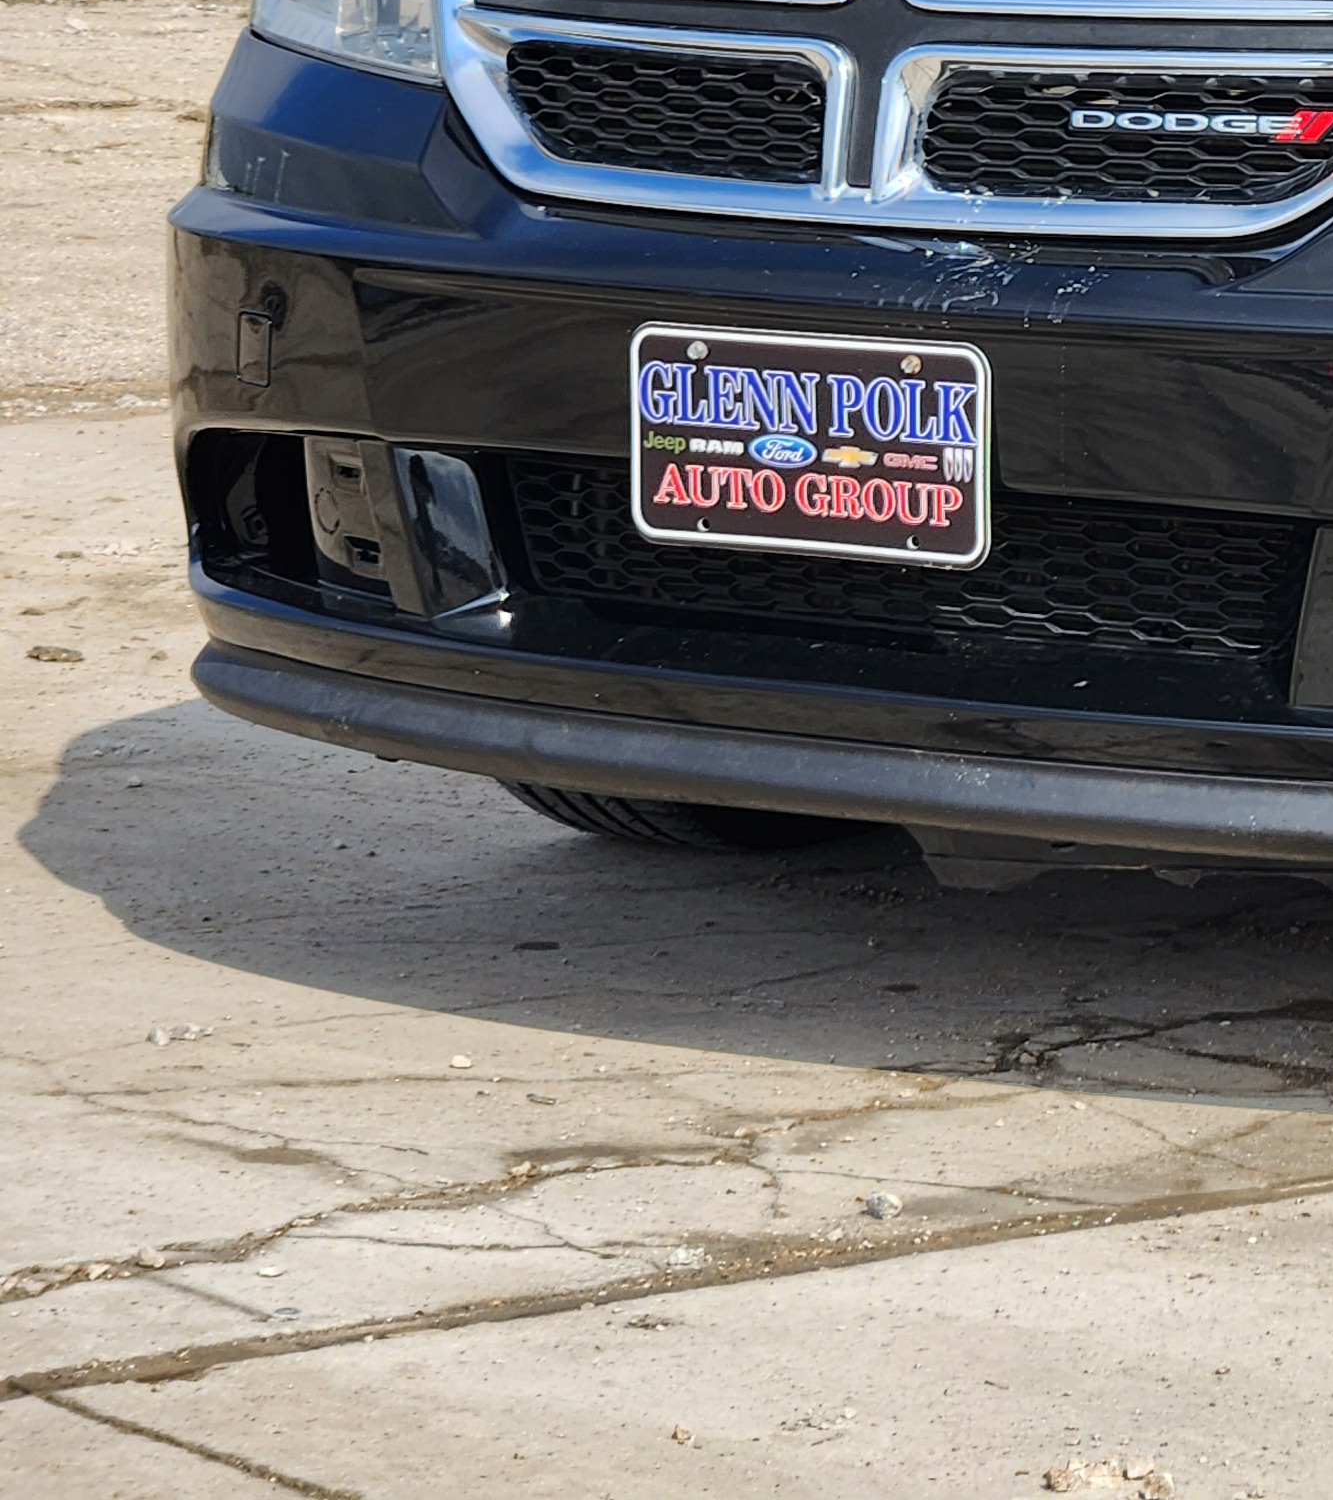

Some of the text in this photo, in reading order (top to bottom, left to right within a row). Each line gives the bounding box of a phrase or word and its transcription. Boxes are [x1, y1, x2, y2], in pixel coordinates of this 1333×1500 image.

[1070, 109, 1303, 135] DODGE
[638, 360, 978, 447] GLENN POLK
[643, 430, 939, 471] Jeep RAM Ford GMC
[653, 462, 964, 528] AUTO GROUP
